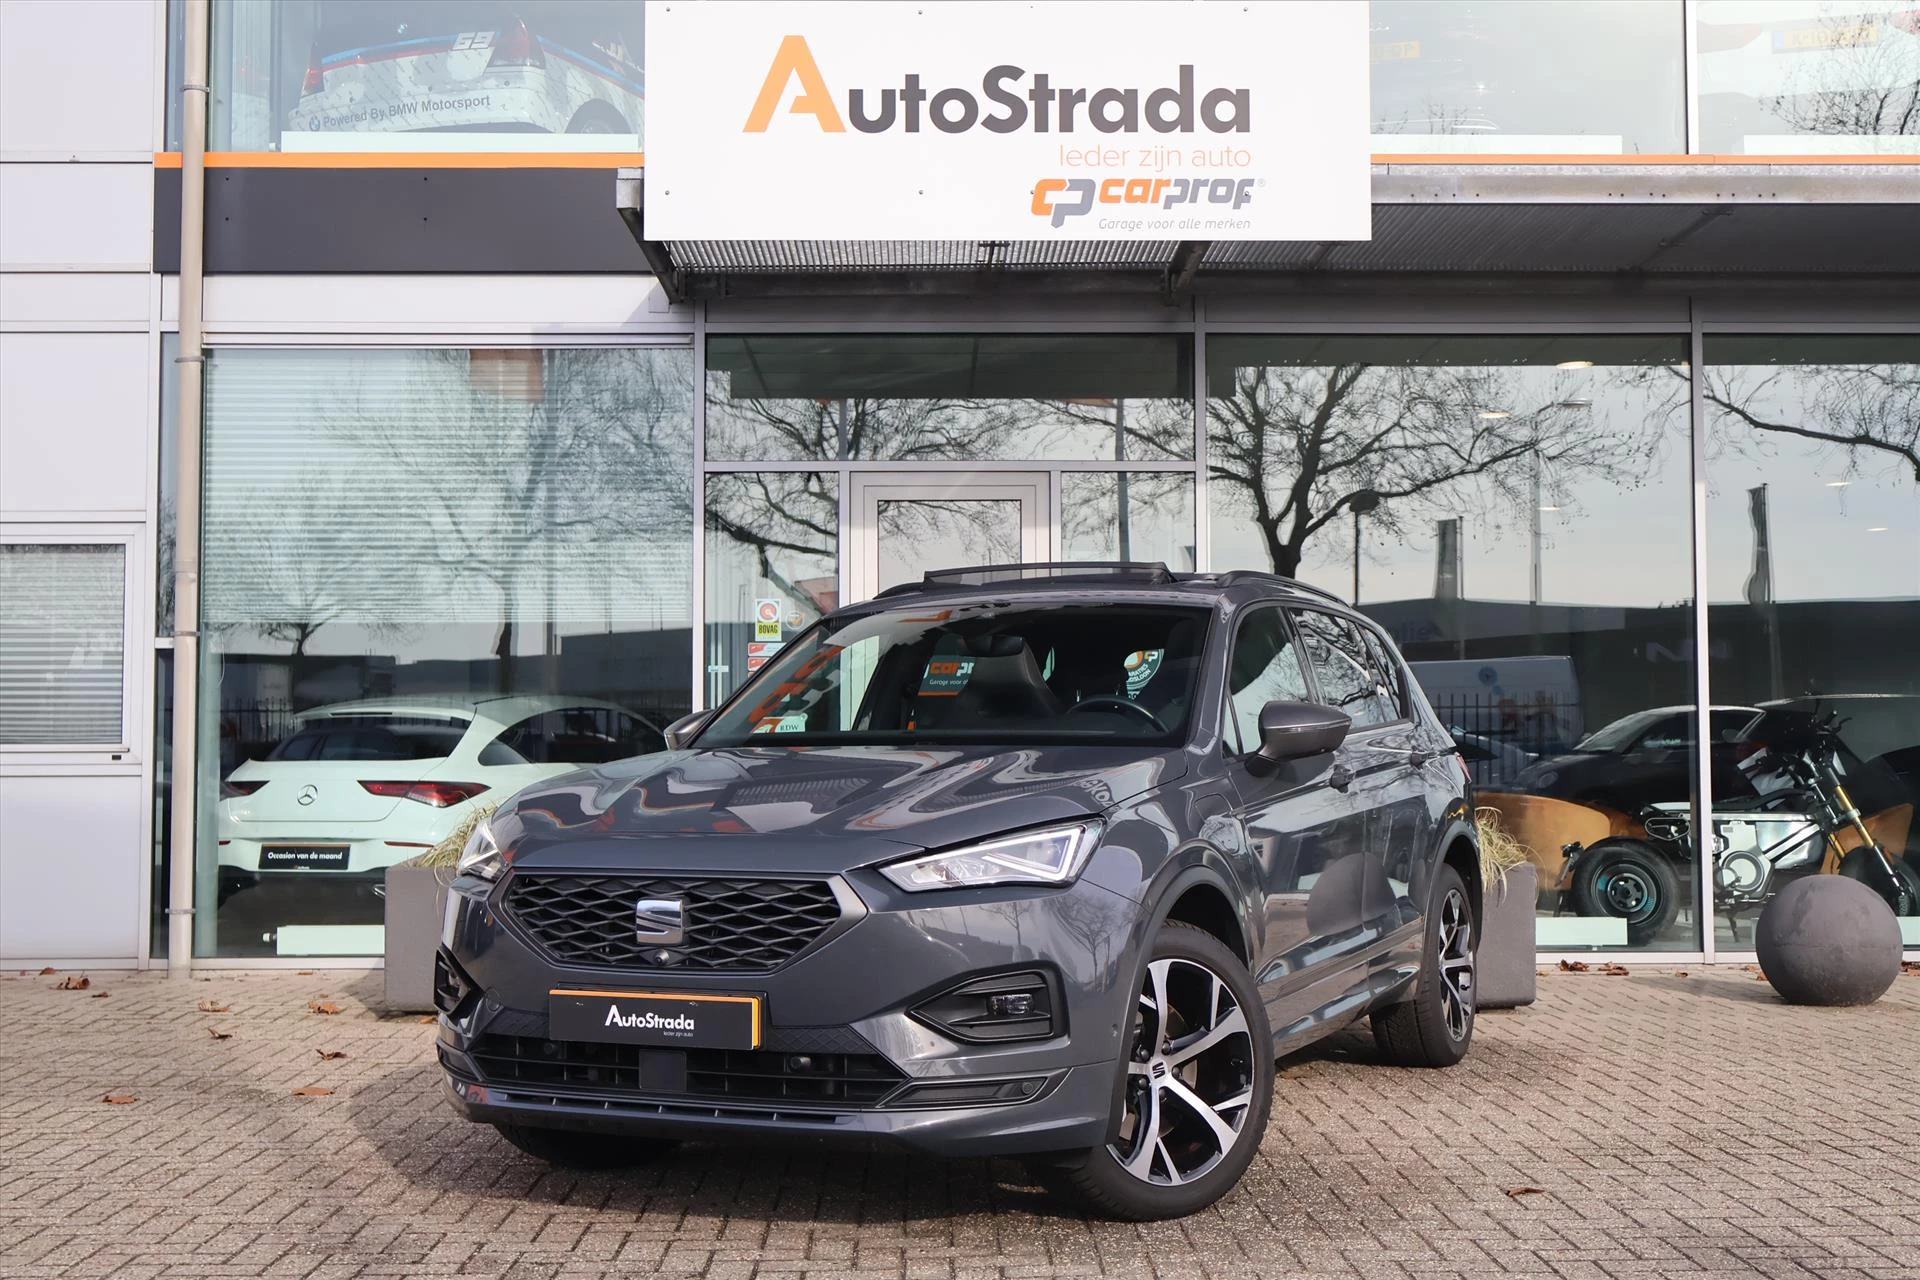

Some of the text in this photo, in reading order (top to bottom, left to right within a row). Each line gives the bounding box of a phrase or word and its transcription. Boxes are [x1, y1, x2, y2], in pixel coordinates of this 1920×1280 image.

[742, 35, 1250, 134] AutoStrada
[323, 95, 491, 128] Powered By BMW Motorsport
[1059, 144, 1252, 173] Ieder zijn auto
[1098, 217, 1251, 232] Garage voor alle merken
[758, 624, 779, 635] BOVAG
[267, 851, 296, 860] Occasion
[310, 852, 318, 860] de
[319, 852, 343, 860] maand
[605, 1004, 695, 1031] AutoStrada
